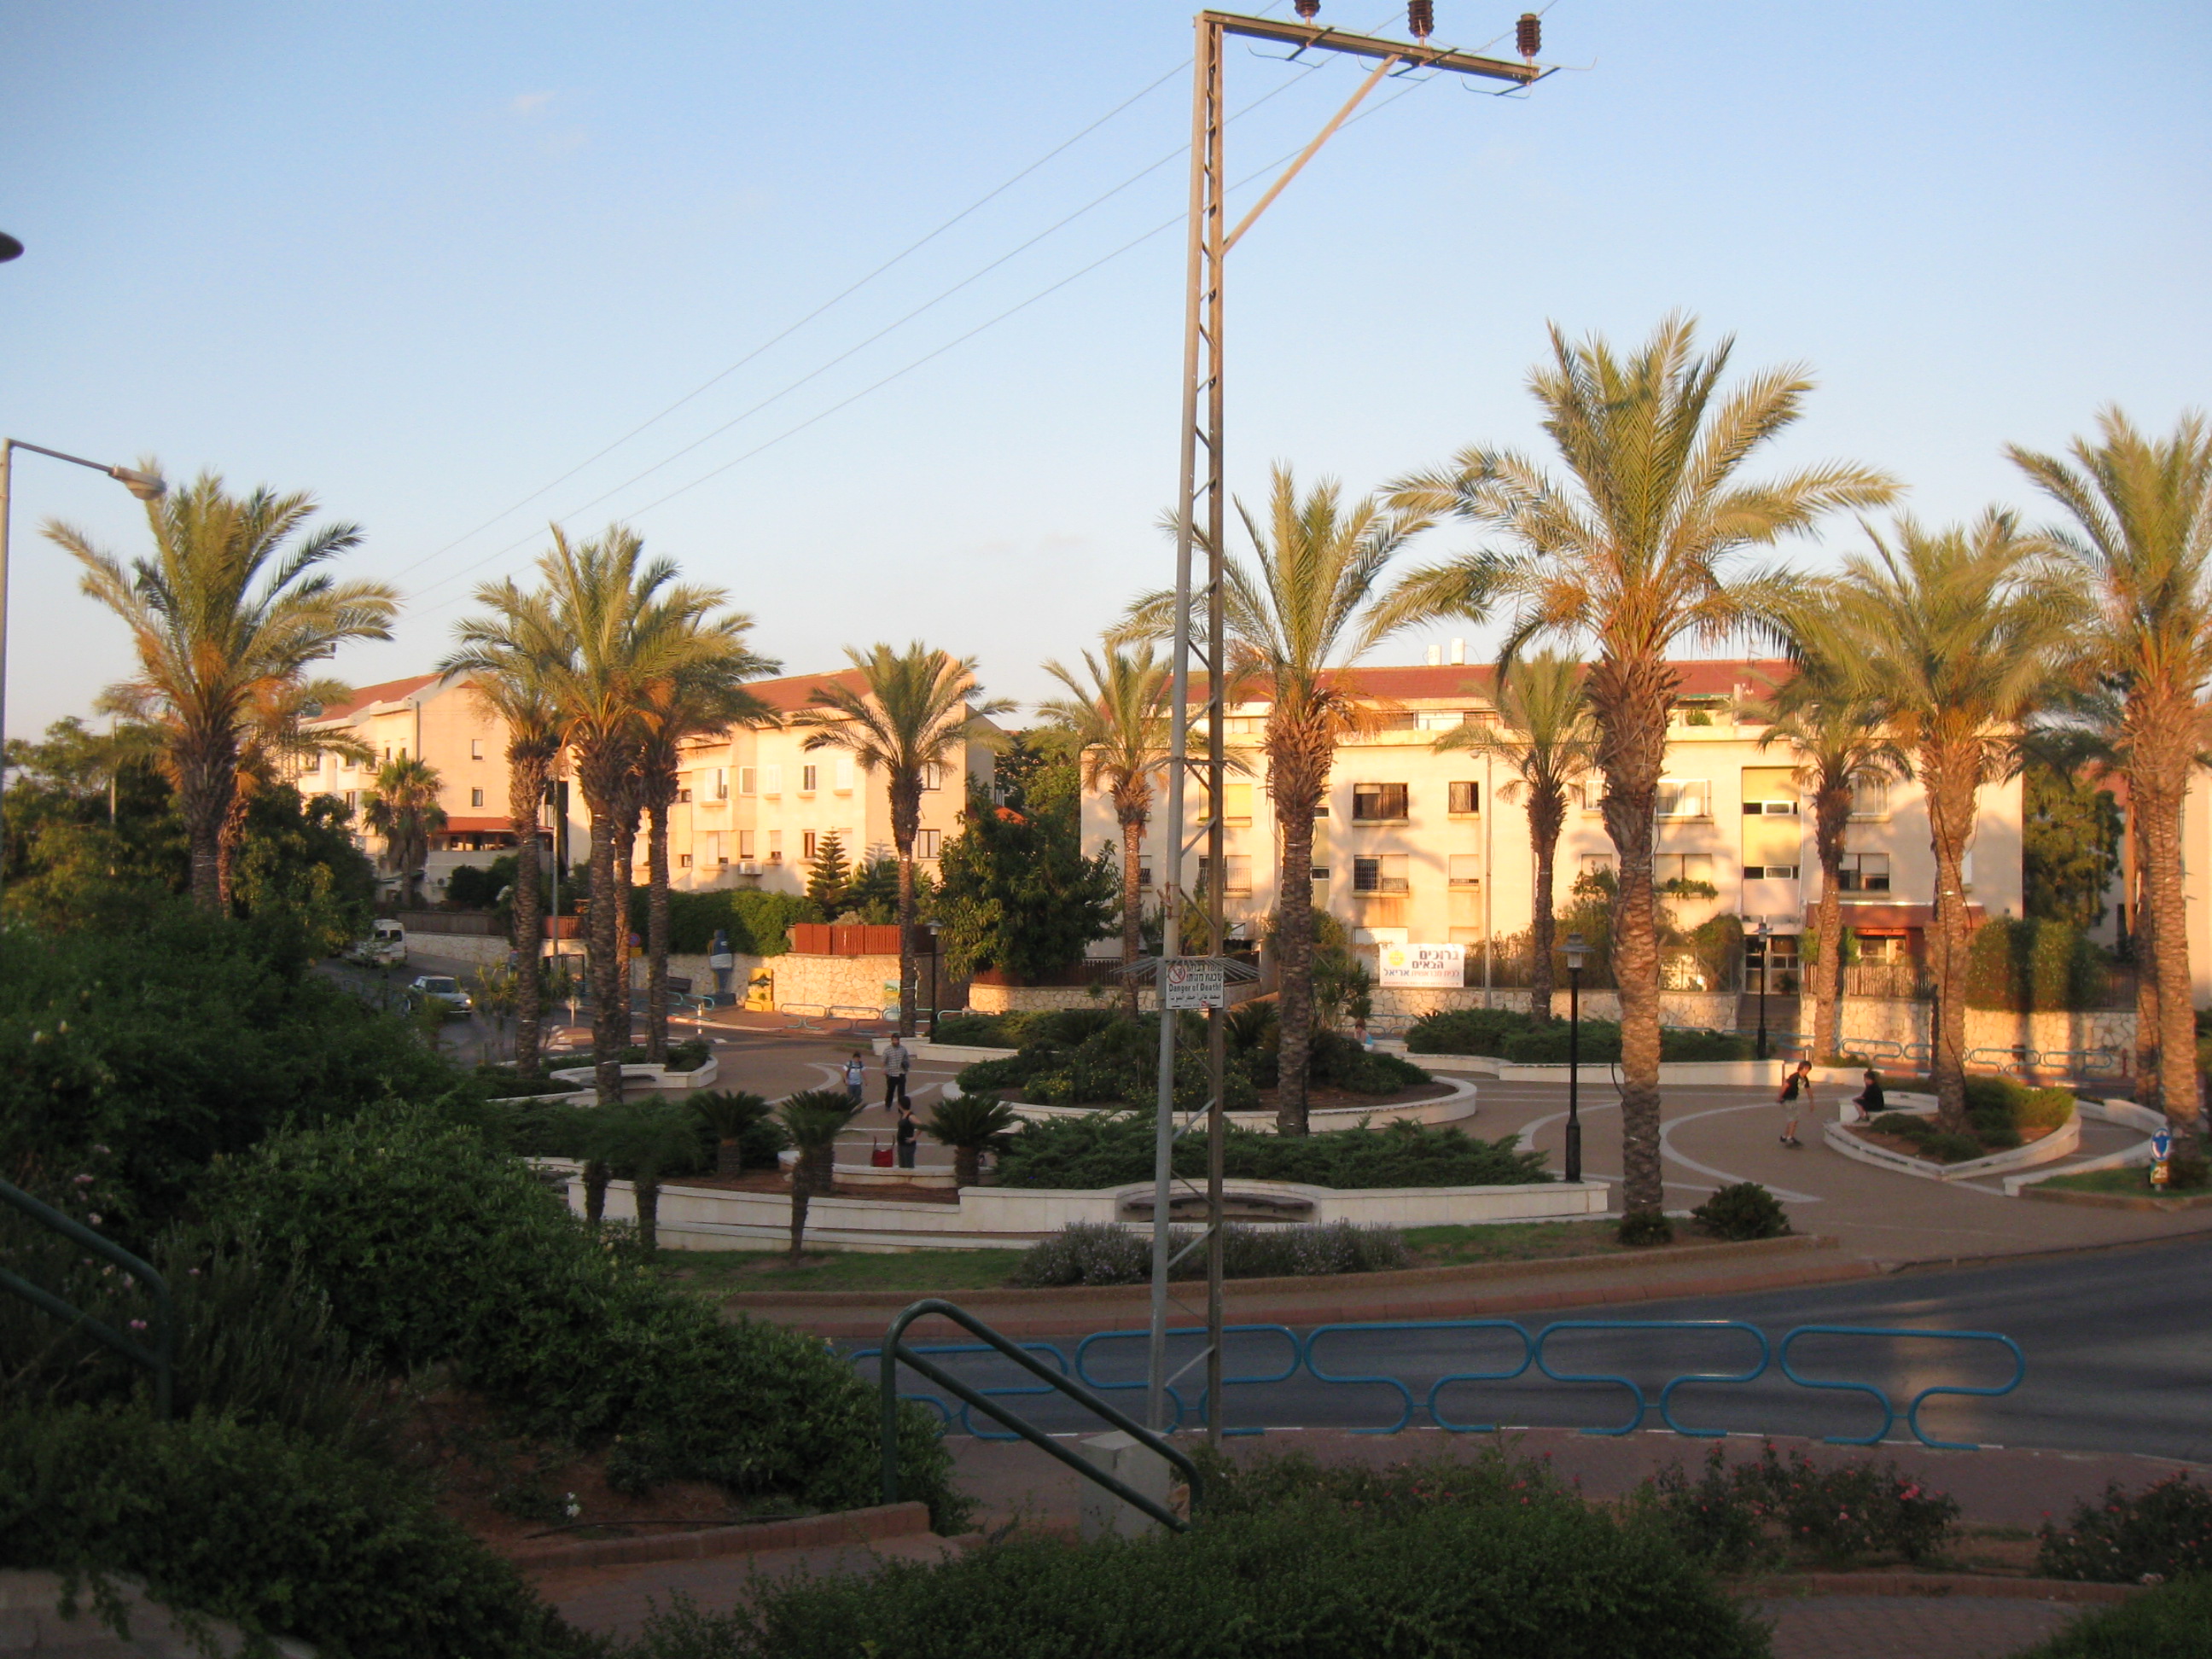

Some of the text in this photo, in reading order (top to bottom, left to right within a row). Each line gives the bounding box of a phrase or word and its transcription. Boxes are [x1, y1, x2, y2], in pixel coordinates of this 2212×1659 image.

[1419, 950, 1459, 960] ברוכים
[1412, 960, 1444, 969] הבאים
[1383, 968, 1410, 976] אריאל
[1168, 983, 1190, 993] Danger
[1192, 983, 1199, 992] of
